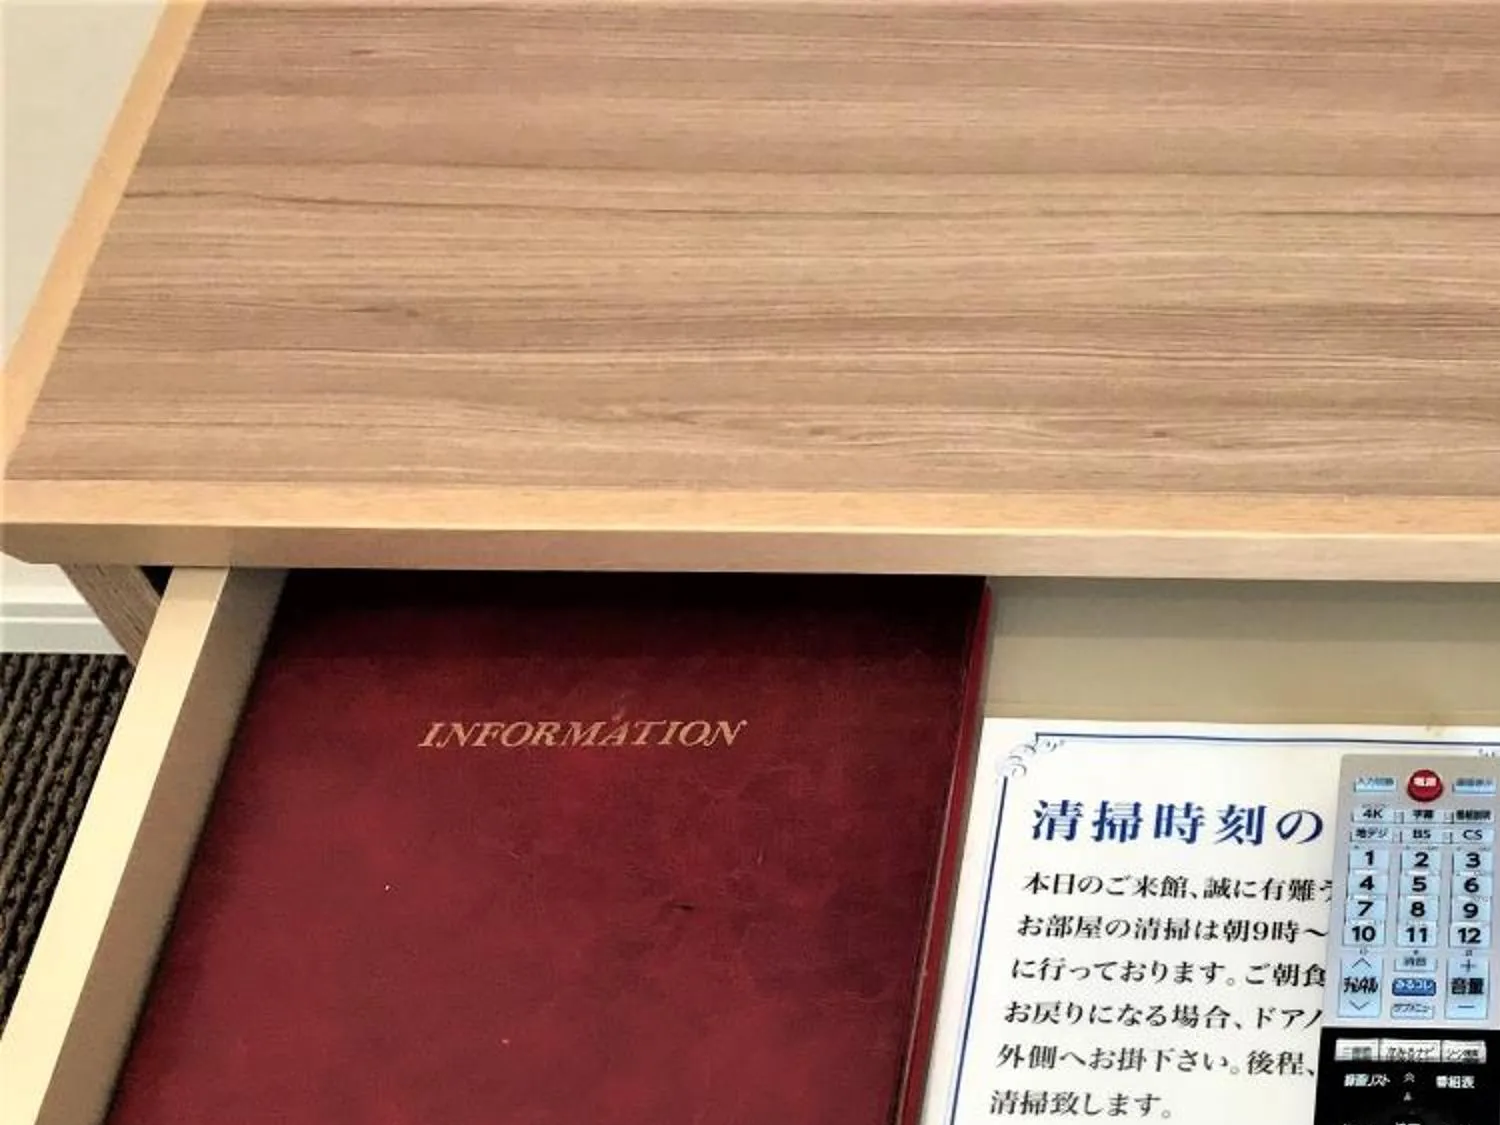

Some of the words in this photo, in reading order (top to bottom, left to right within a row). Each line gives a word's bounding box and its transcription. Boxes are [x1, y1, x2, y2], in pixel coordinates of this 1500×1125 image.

[417, 719, 748, 747] INFORMATION
[1032, 799, 1324, 845] 清掃時刻の
[1362, 808, 1384, 820] 4K
[1462, 828, 1482, 840] CS
[1365, 850, 1374, 866] 1
[1413, 851, 1429, 868] 2
[1465, 852, 1480, 868] 3
[1359, 875, 1374, 891] 4
[1412, 876, 1427, 892] 5
[1464, 877, 1479, 893] 6
[1358, 900, 1374, 917] 7
[1410, 901, 1426, 917] 8
[1463, 902, 1478, 918] 9
[1351, 926, 1377, 942] 10
[1405, 926, 1428, 942] 11
[1457, 927, 1482, 943] 12
[1451, 977, 1485, 995] 音量
[989, 1089, 1171, 1119] 清掃致します。
